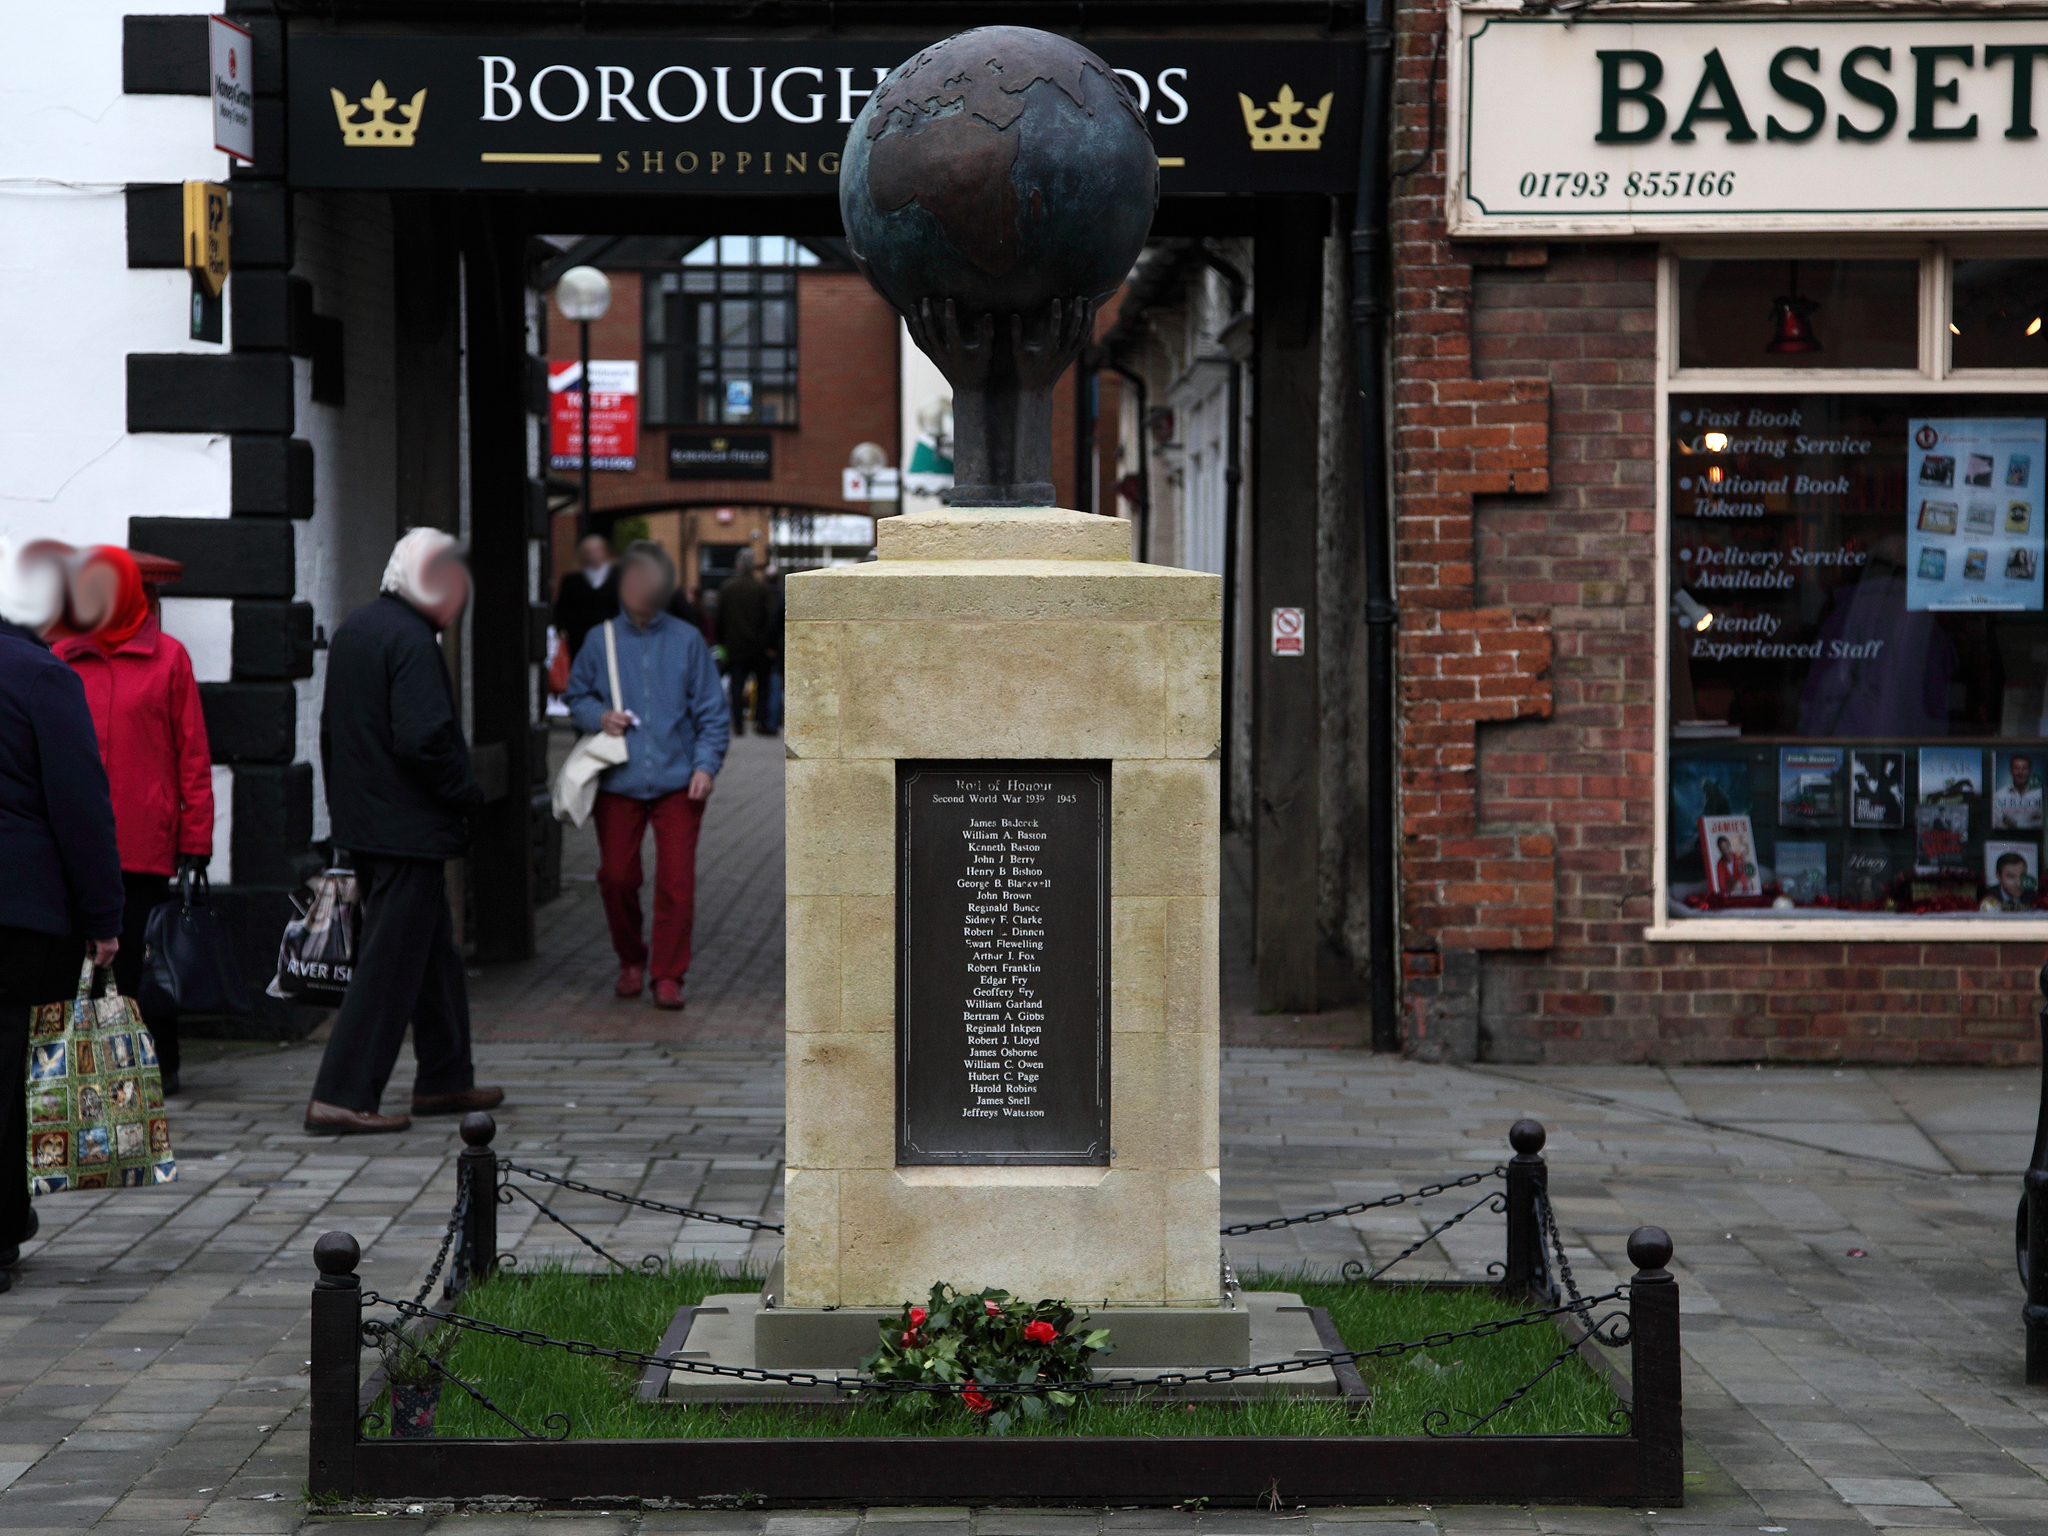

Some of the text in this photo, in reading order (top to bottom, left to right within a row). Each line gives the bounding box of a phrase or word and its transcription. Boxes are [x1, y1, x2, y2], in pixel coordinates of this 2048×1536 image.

[479, 55, 890, 123] BOROUGH
[616, 150, 841, 174] SHOPPING
[1519, 170, 1736, 198] 01793 855166
[1695, 409, 1802, 428] Fast Book
[1692, 435, 1871, 458] Odering Service
[1695, 475, 1849, 495] National Book
[1694, 499, 1765, 518] Tokens
[1696, 547, 1867, 569] Delivery Service
[1694, 570, 1795, 590] Available
[1698, 614, 1782, 636] riendly
[1691, 639, 1884, 661] Experienced Staff
[987, 779, 1000, 792] of
[932, 793, 965, 804] Second
[968, 793, 998, 804] World
[1001, 794, 1022, 804] War
[1057, 794, 1077, 804] 1945
[969, 818, 997, 828] James
[962, 830, 999, 840] William
[967, 842, 1007, 852] Kenneth
[973, 854, 995, 864] John
[1009, 854, 1036, 865] Berry
[966, 866, 995, 877] Henry
[956, 878, 990, 891] George
[976, 890, 1032, 901] John Brown
[967, 902, 1009, 915] Reginald
[964, 914, 996, 925] Sidney
[1012, 914, 1043, 925] Clarke
[963, 926, 994, 937] Robert
[996, 938, 1044, 951] Flewelling
[1018, 951, 1036, 961] Fox
[967, 962, 1041, 973] Robert Franklin
[979, 974, 1028, 987] Edgar Fry
[1018, 987, 1035, 999] Fry
[964, 999, 1043, 1009] William Garland
[962, 1011, 1000, 1021] Bertram
[1017, 1011, 1045, 1021] Gibbs
[965, 1023, 1042, 1036] Reginald Inkpen
[967, 1035, 999, 1045] Robert
[1013, 1035, 1040, 1047] Lloyd
[969, 1047, 1039, 1058] James Osborne
[963, 1059, 1001, 1069] William
[1017, 1059, 1044, 1070] Owen
[967, 1071, 1000, 1082] Hubert
[1017, 1071, 1040, 1084] Page
[969, 1083, 1038, 1094] Harold Robins
[976, 1095, 1031, 1106] James Snell
[961, 1107, 999, 1120] Jeffreys
